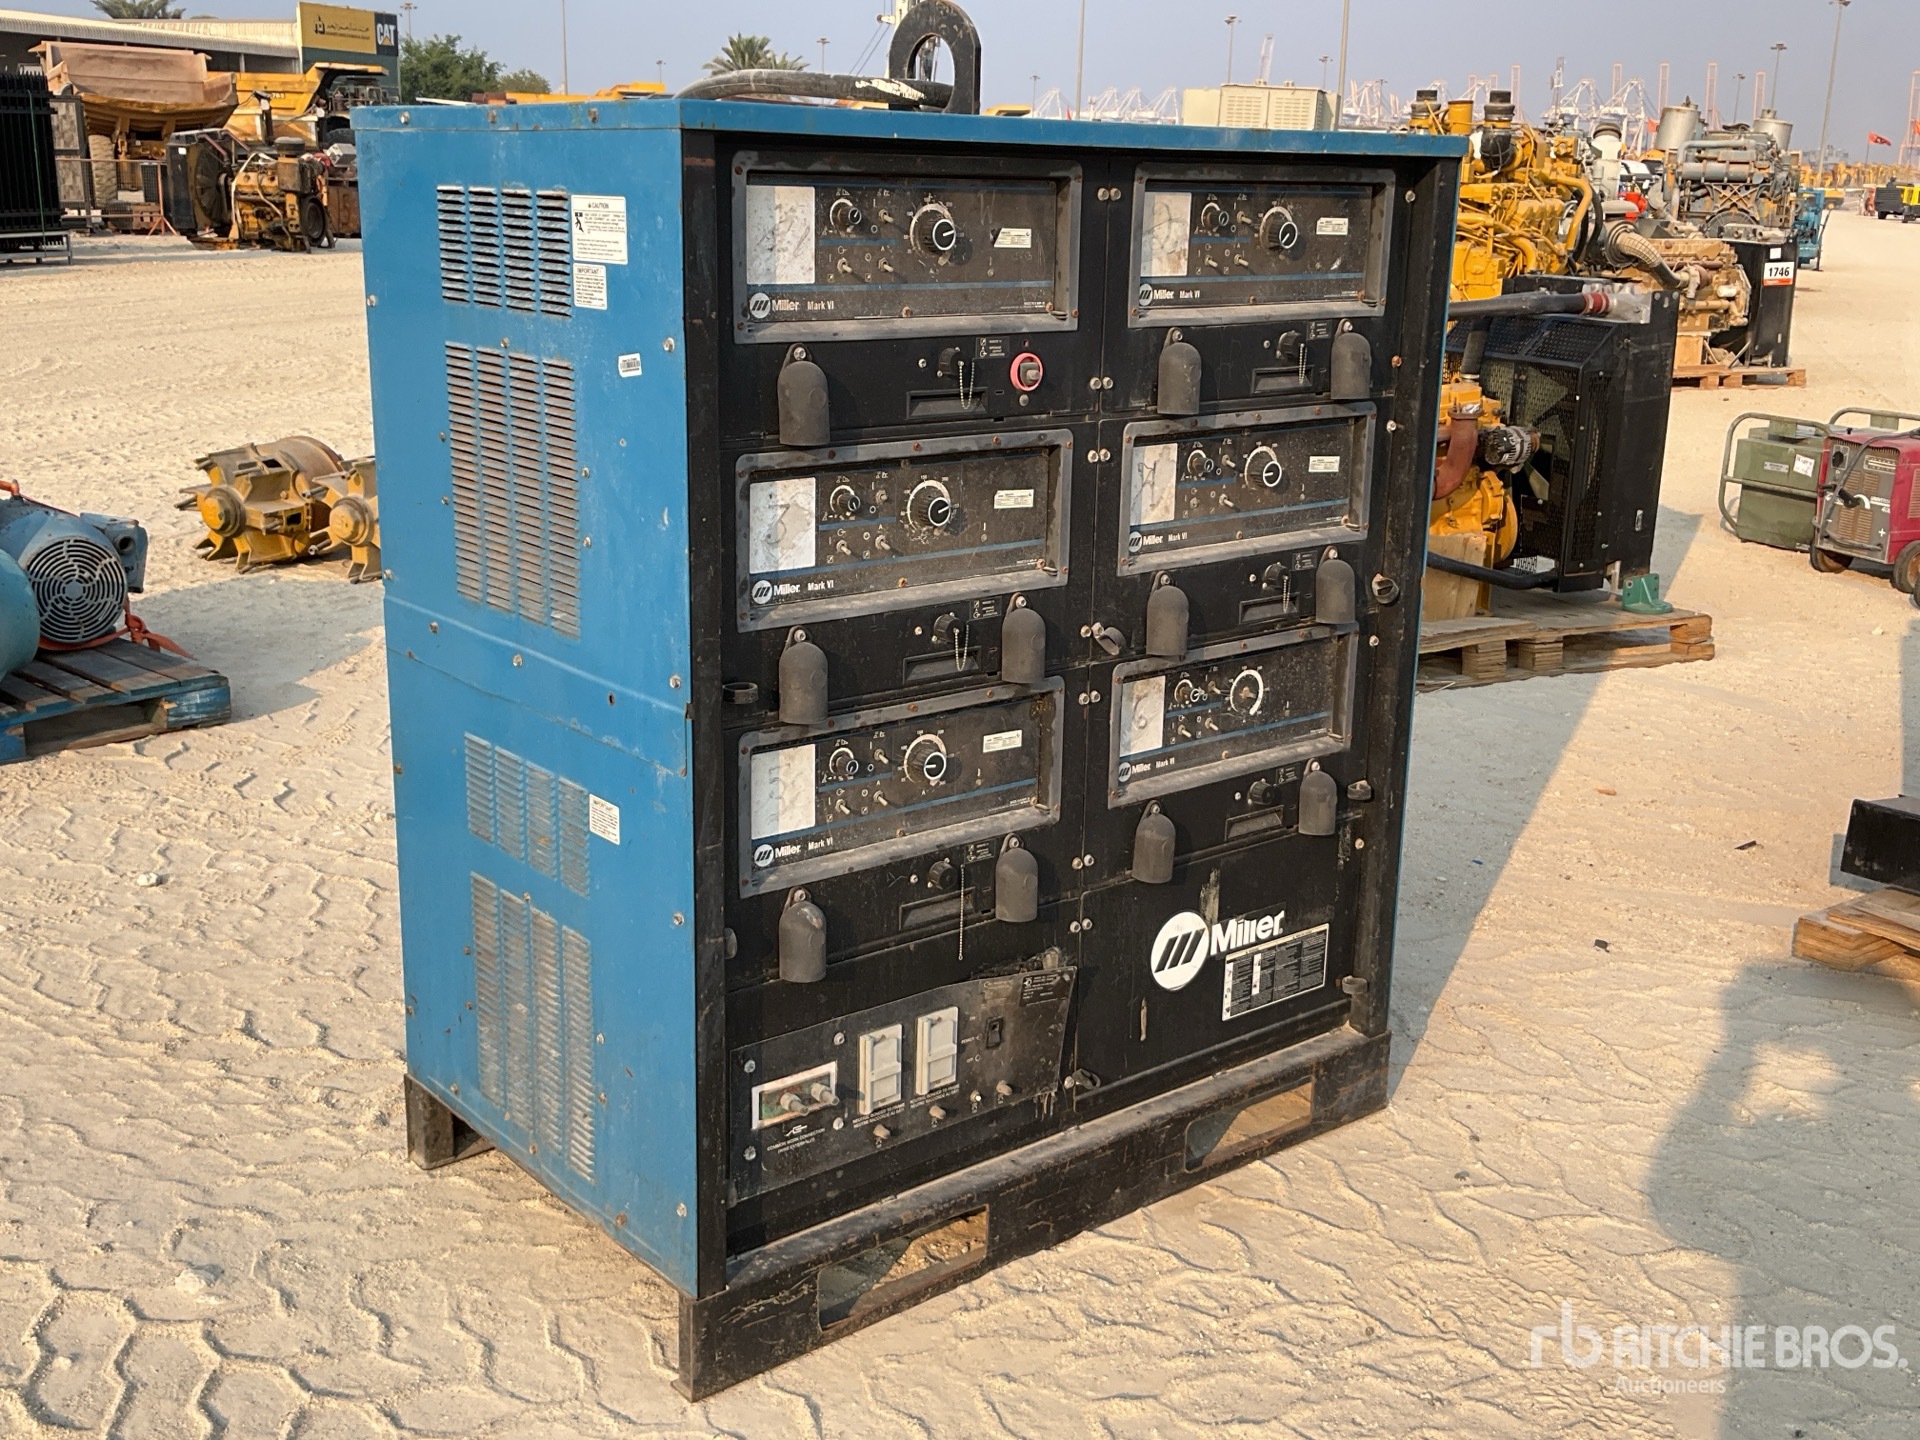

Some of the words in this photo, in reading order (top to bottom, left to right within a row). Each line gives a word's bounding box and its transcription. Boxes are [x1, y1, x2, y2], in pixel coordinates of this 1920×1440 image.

[376, 23, 396, 45] CAT
[1769, 267, 1790, 277] 1746
[1153, 289, 1174, 300] Miller
[1179, 290, 1193, 299] Mark
[772, 299, 800, 312] Miller
[807, 301, 825, 310] Mark
[826, 300, 834, 310] VI
[1142, 534, 1164, 546] Miller
[1167, 532, 1181, 542] Mark
[773, 583, 800, 596] Miller
[807, 581, 825, 591] Mark
[826, 579, 834, 589] VI
[774, 844, 802, 859] Miller
[807, 839, 825, 851] Mark
[825, 836, 834, 847] VI
[1209, 909, 1286, 957] Miller
[799, 1127, 826, 1141] CONNECTION
